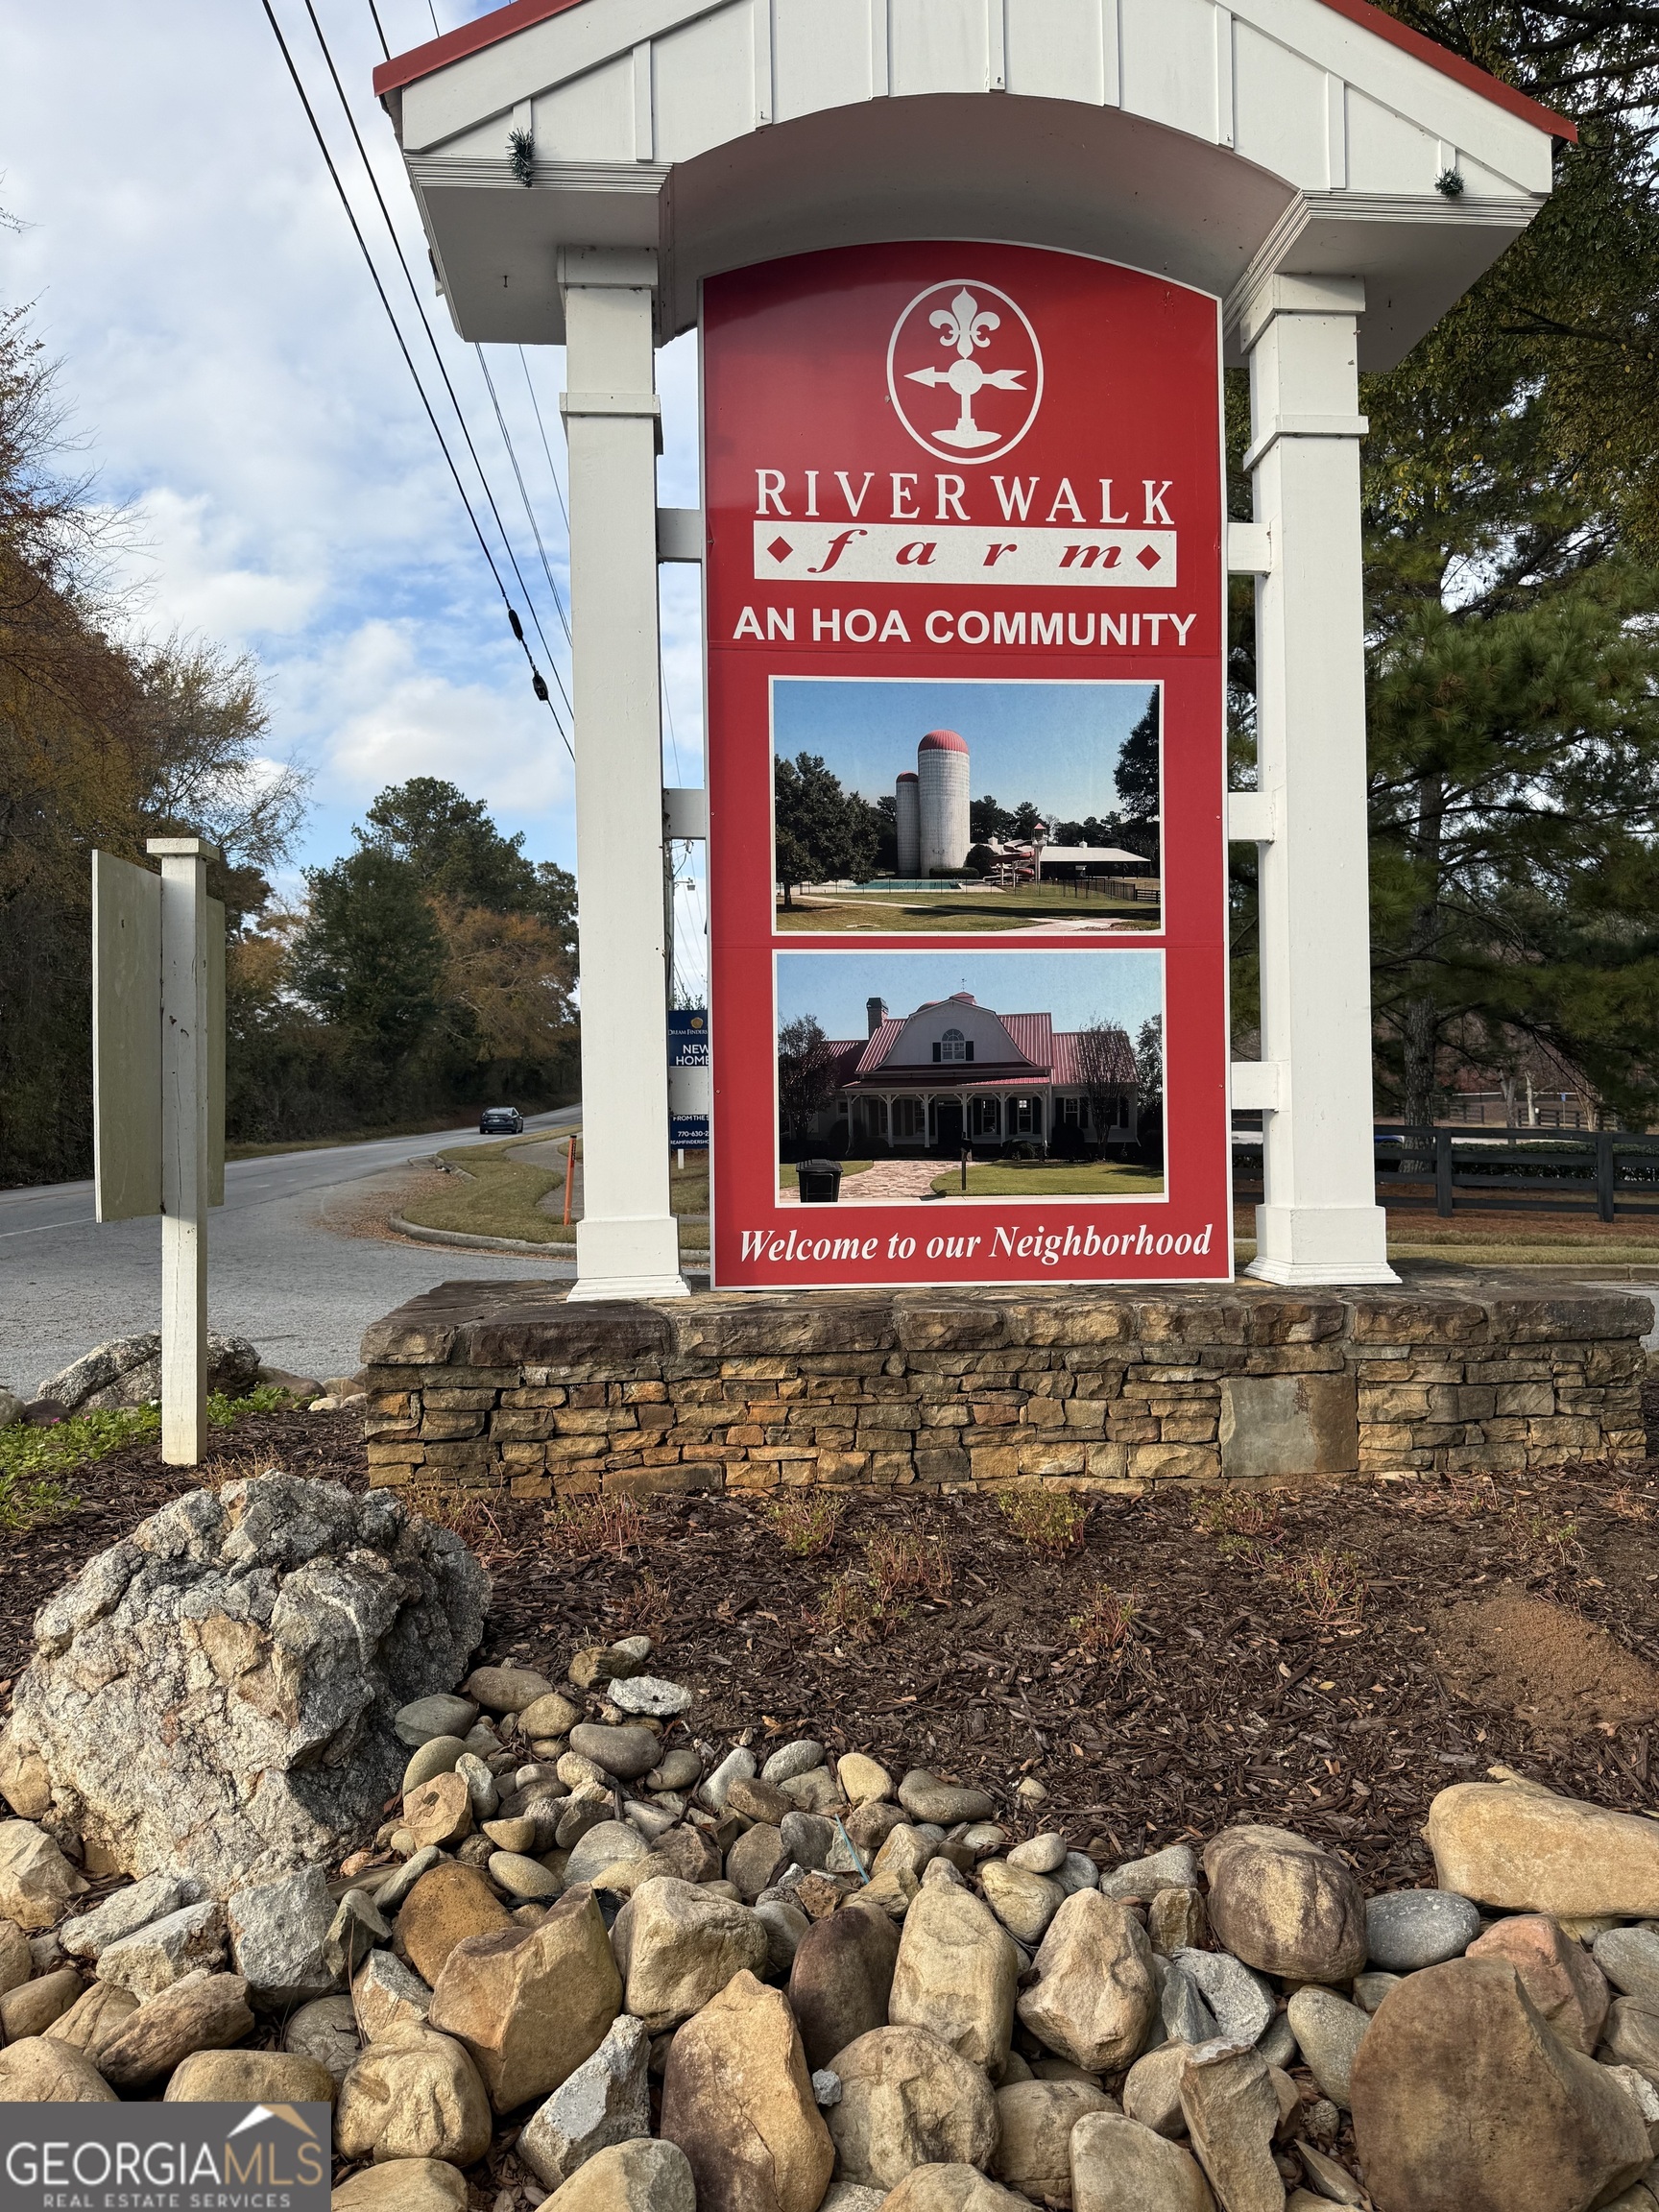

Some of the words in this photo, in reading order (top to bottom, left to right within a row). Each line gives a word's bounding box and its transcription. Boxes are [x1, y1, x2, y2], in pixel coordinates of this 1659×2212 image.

[733, 606, 795, 641] AN
[812, 608, 912, 643] HOA
[925, 610, 1197, 646] COMMUNITY
[683, 1044, 709, 1054] NEW
[741, 1229, 878, 1262] Welcome
[887, 1232, 917, 1260] to
[926, 1236, 981, 1259] our
[988, 1223, 1214, 1266] Neighborhood
